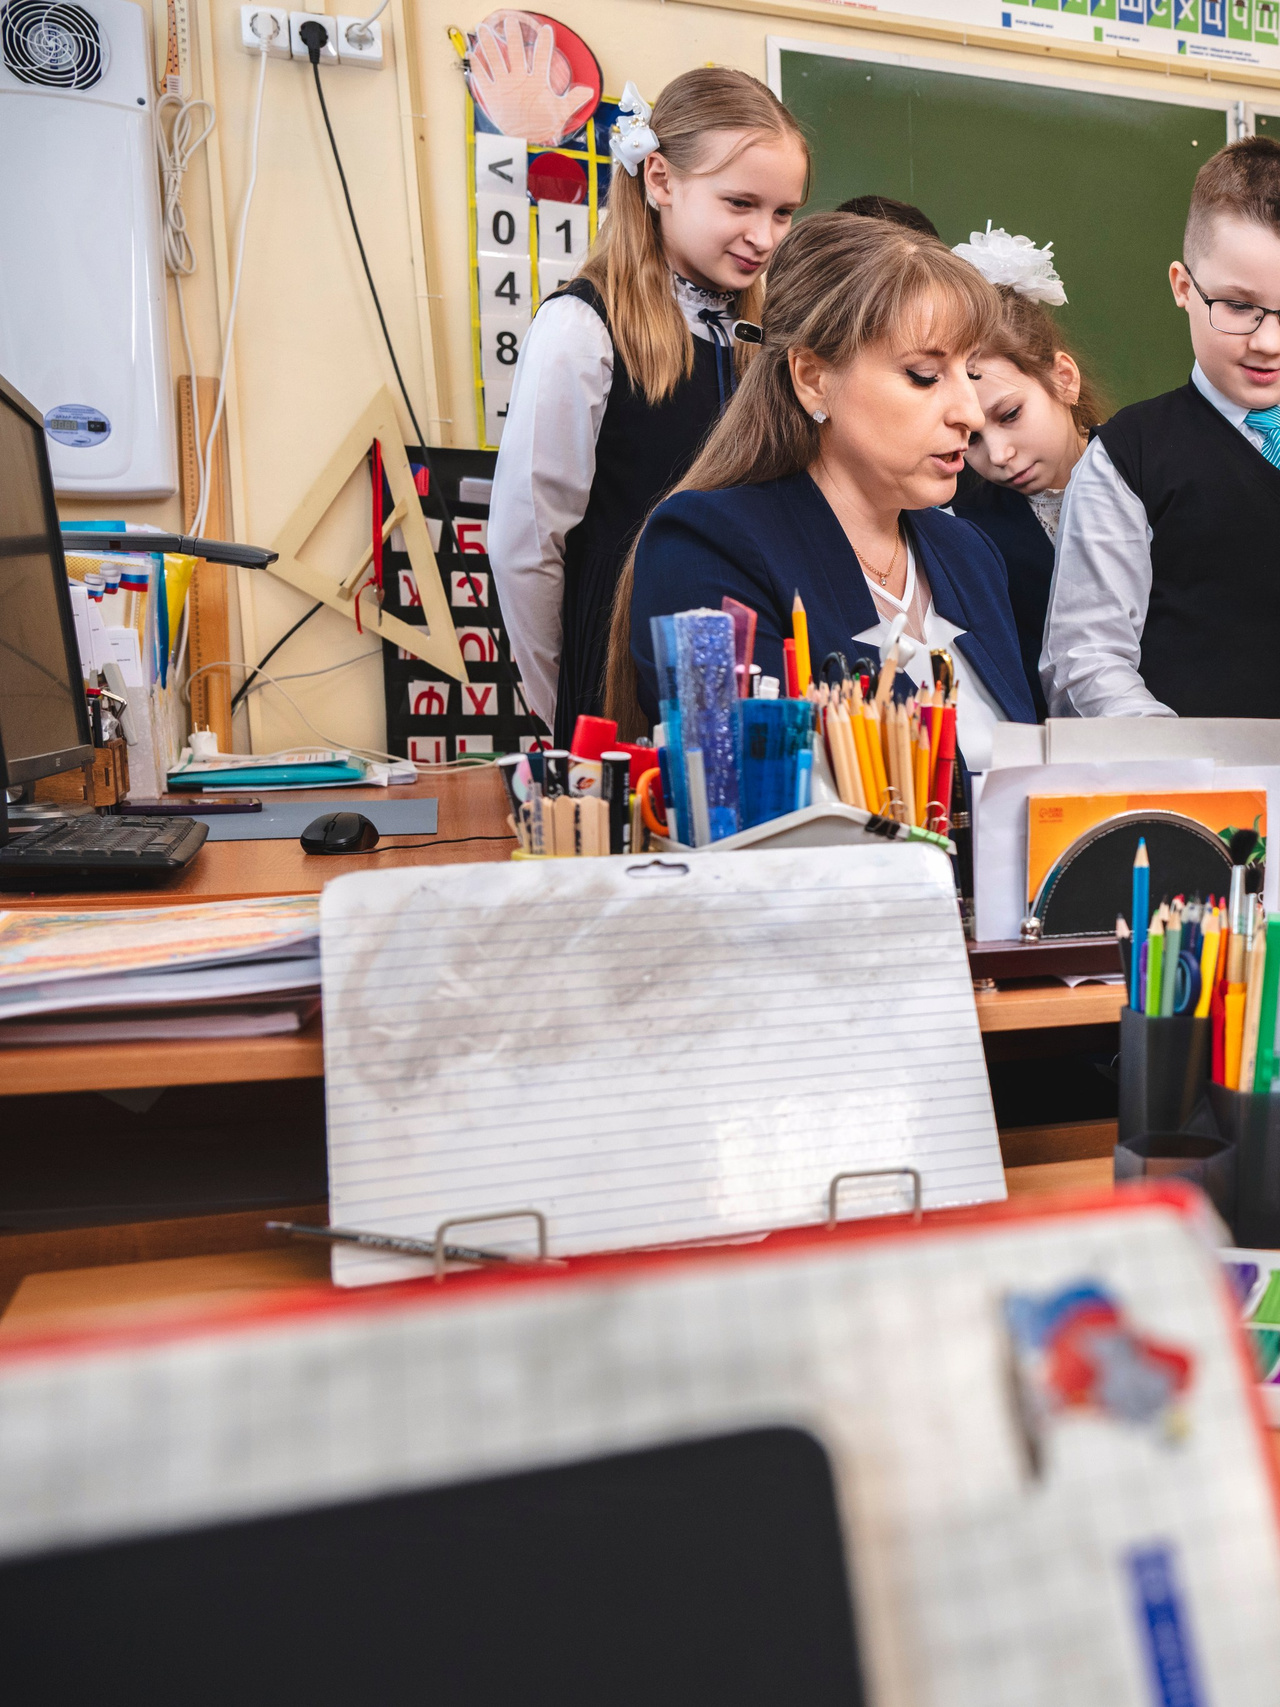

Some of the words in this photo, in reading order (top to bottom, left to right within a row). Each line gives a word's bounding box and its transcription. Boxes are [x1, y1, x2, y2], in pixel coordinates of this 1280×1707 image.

[492, 210, 515, 245] 0
[555, 219, 572, 254] 1
[495, 271, 520, 306] 4
[496, 331, 519, 366] 8
